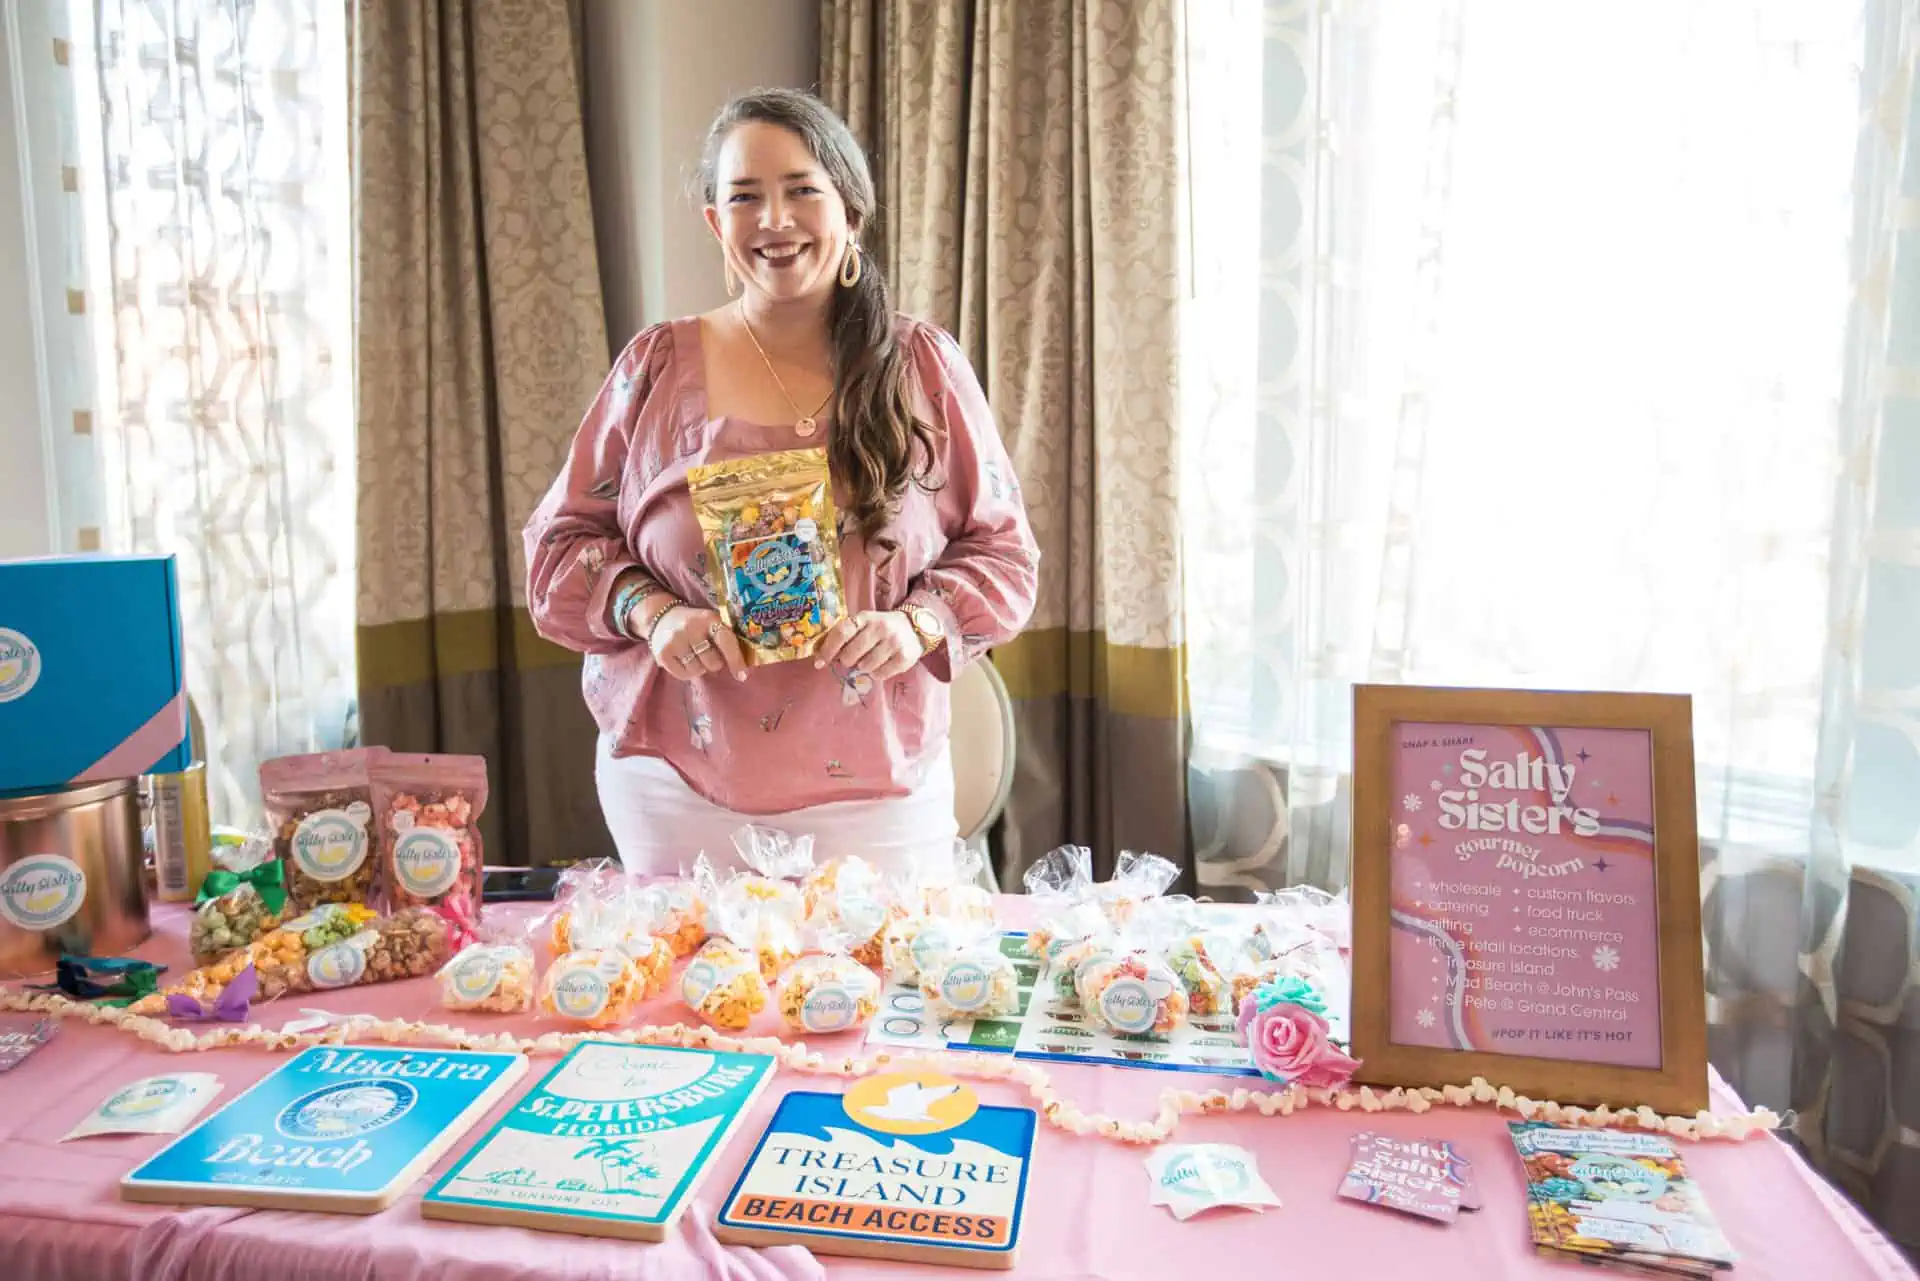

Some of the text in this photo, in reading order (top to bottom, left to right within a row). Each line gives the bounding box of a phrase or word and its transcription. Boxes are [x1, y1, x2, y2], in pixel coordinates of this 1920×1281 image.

[1459, 748, 1577, 803] Salty
[1438, 789, 1601, 837] Sisters
[1454, 837, 1542, 862] gourmet
[1496, 854, 1585, 880] popcorn
[1428, 880, 1502, 896] wholesale
[1527, 886, 1636, 905] custom flavors
[1428, 899, 1490, 917] catering
[1527, 905, 1605, 922] food truck
[1528, 924, 1624, 943] ecommerce
[1428, 935, 1578, 959] thre retail locations
[1446, 956, 1555, 977] Trasure Island
[1484, 978, 1533, 994] Beach
[1552, 983, 1602, 1000] John's
[1605, 987, 1641, 1004] Pass
[1464, 994, 1498, 1010] Pete
[1518, 999, 1567, 1015] Grand
[1570, 1003, 1628, 1021] Central
[1491, 1027, 1633, 1043] #POP IT LIKE IT'S HOT
[299, 1050, 492, 1081] Madeira
[558, 1064, 756, 1122] PETERSBURG
[551, 1116, 679, 1138] FLORIDA
[201, 1132, 373, 1177] Beach
[771, 1147, 1010, 1184] TREASURE
[792, 1174, 967, 1207] ISLAND
[743, 1198, 997, 1239] BEACH ACCESS
